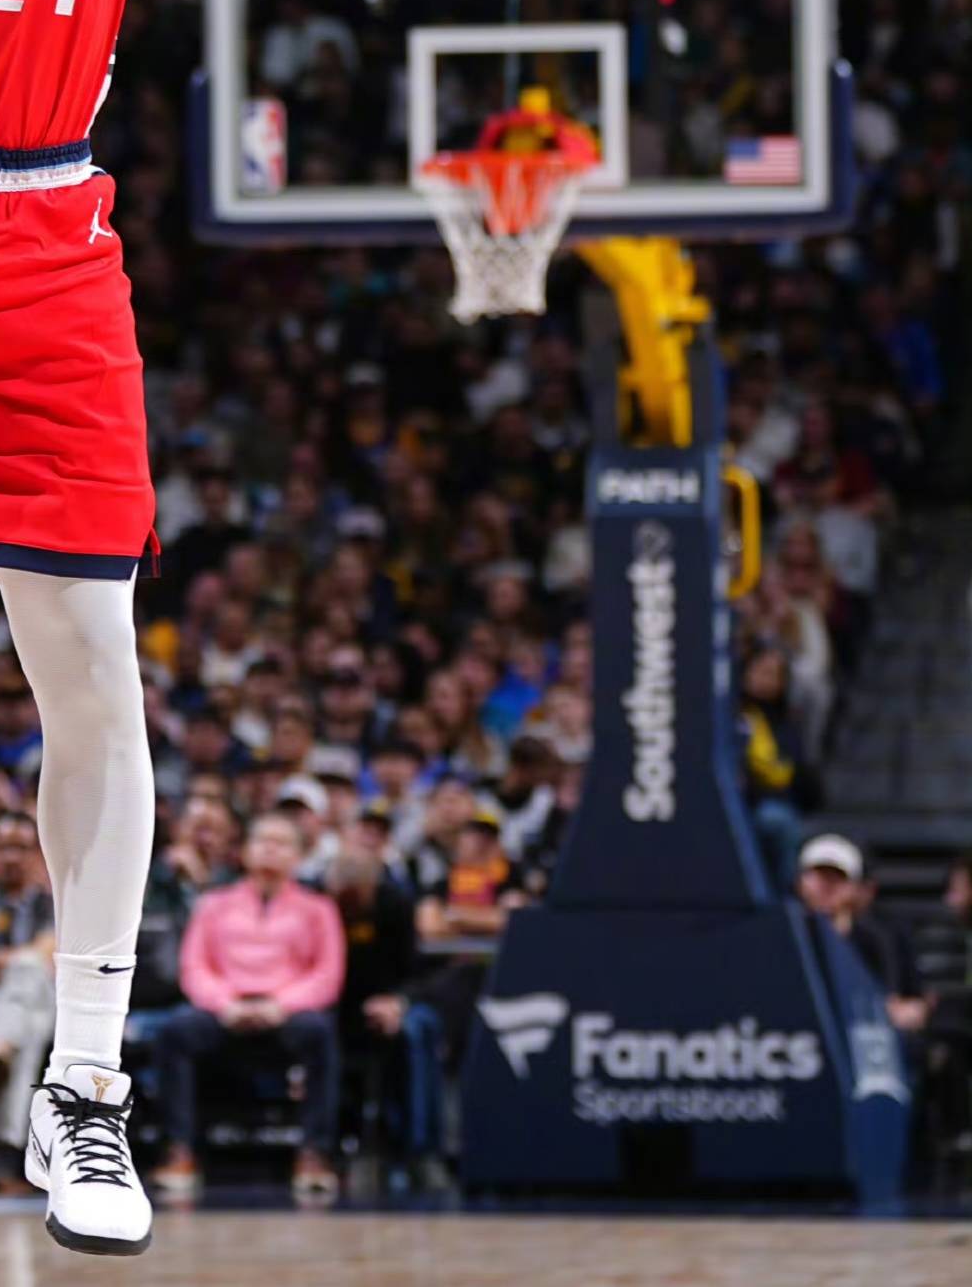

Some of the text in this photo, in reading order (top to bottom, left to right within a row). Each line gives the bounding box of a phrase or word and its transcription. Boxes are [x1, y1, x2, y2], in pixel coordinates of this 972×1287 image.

[622, 558, 676, 821] Southwest
[572, 1013, 822, 1079] Fanatics
[573, 1081, 784, 1124] Sportsbook
